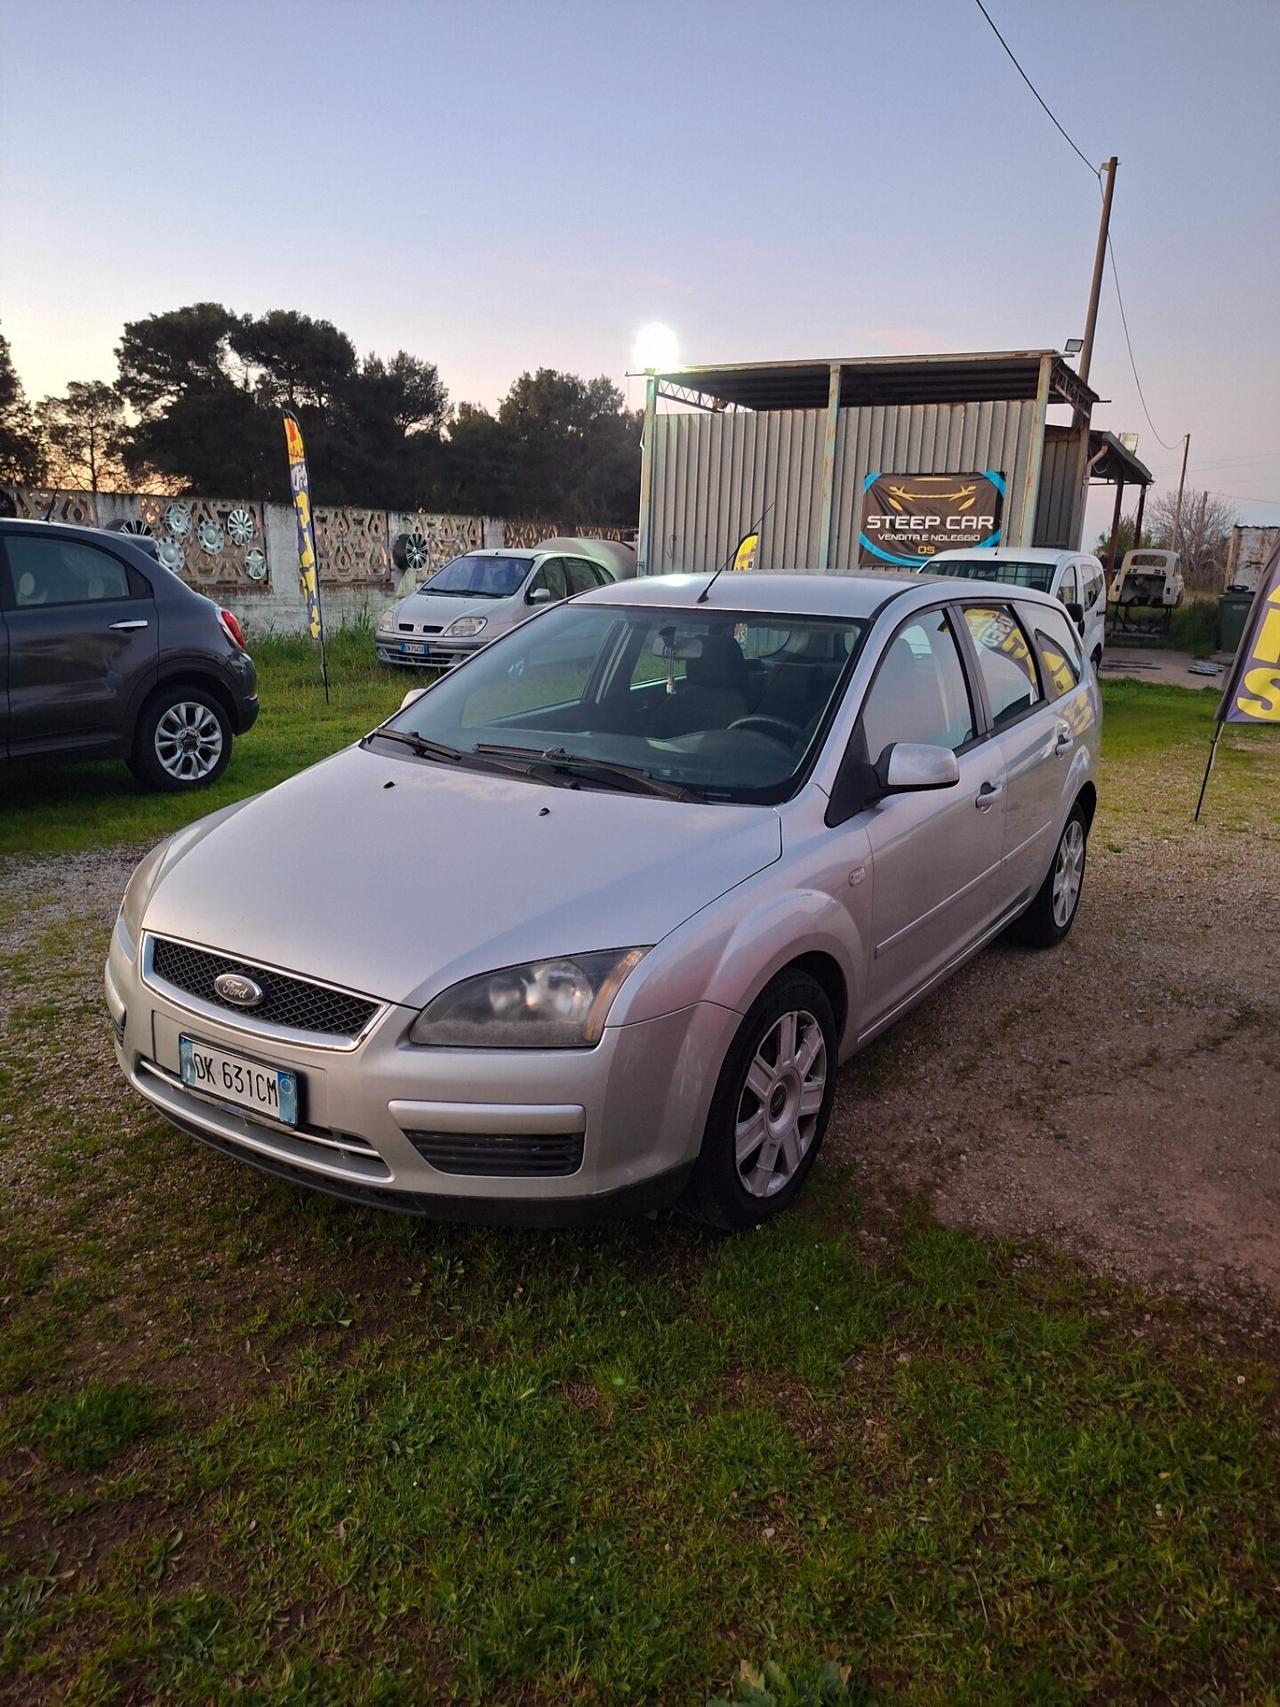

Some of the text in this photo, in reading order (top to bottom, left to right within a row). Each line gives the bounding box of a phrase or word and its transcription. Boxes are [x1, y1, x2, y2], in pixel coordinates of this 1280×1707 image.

[866, 515, 994, 530] STEEP CAR
[878, 533, 920, 541] VENDITA
[930, 534, 980, 542] NOLEGGIO
[223, 979, 249, 999] Ford
[193, 1052, 279, 1108] DK 631CM
